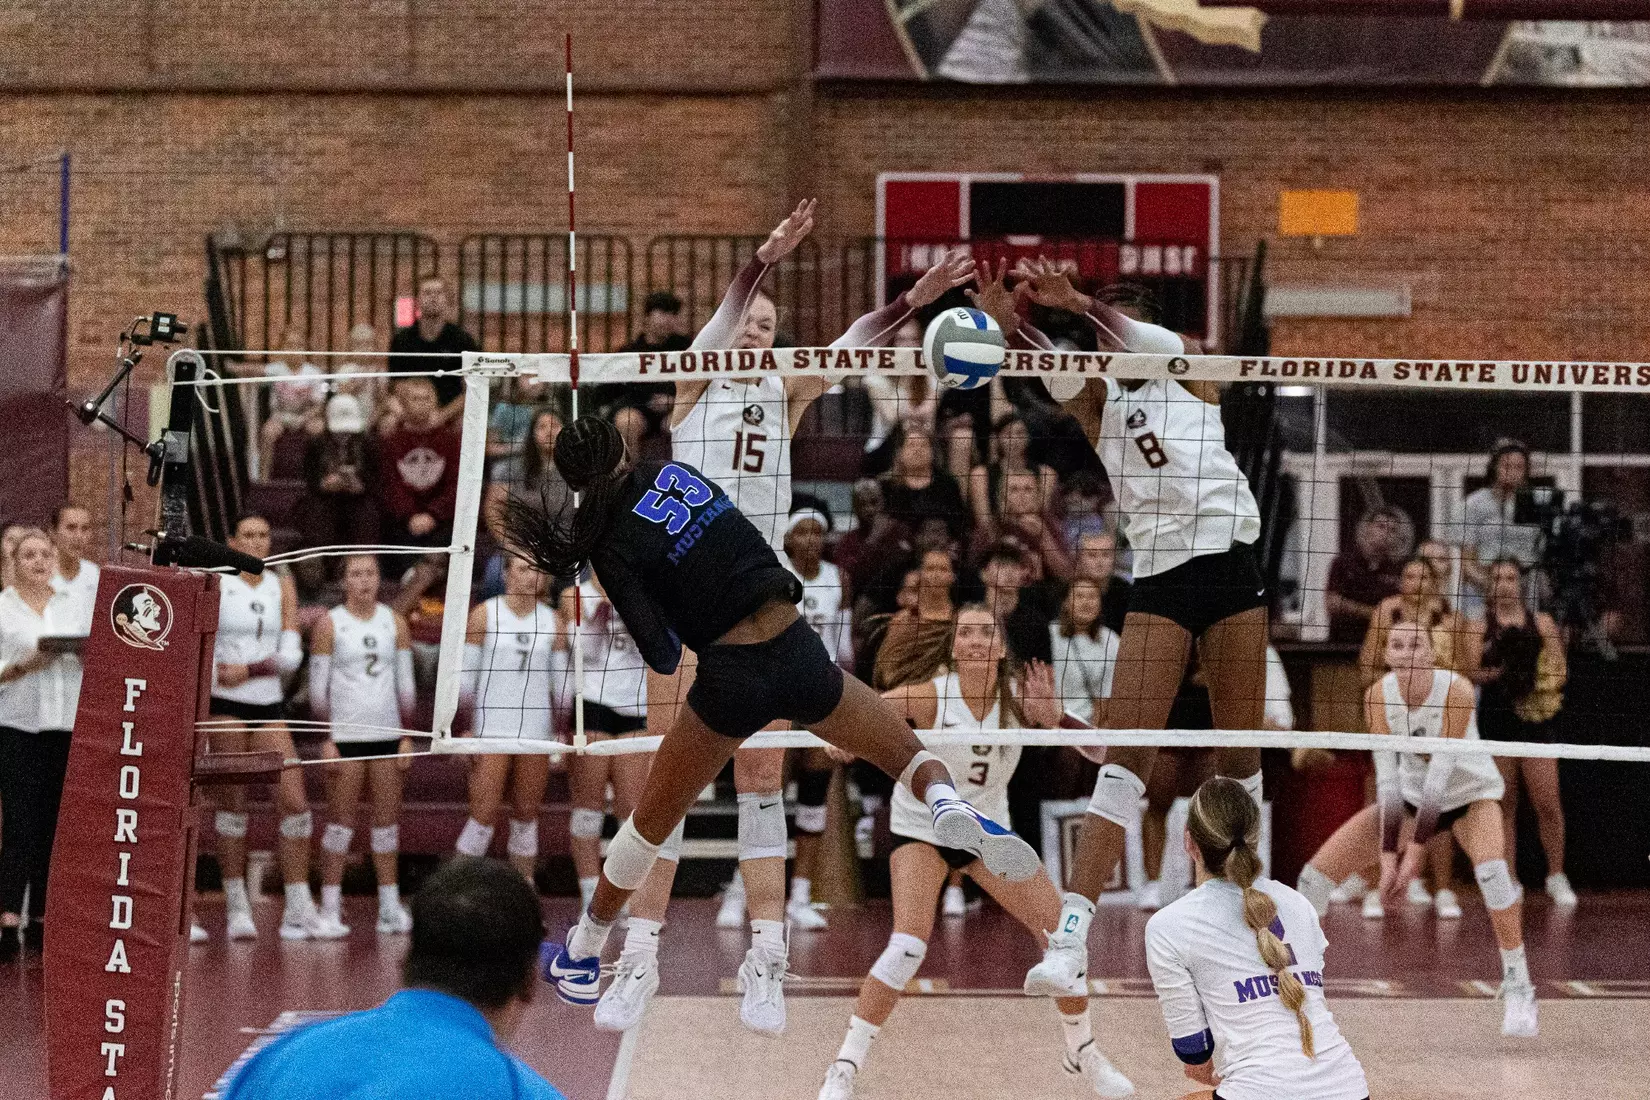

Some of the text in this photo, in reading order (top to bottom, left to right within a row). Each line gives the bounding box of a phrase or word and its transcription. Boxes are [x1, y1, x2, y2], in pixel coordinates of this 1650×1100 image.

[638, 349, 1113, 374] FLORIDA STATE UERSITY
[1239, 360, 1377, 379] FLORIDA
[1393, 361, 1496, 382] STATE
[732, 431, 767, 473] 15
[1134, 431, 1169, 469] 8
[632, 463, 713, 535] 53
[517, 650, 529, 672] 7
[968, 762, 990, 786] 3
[105, 678, 147, 974] FLORIDA
[1233, 970, 1324, 1004] MUSNGS
